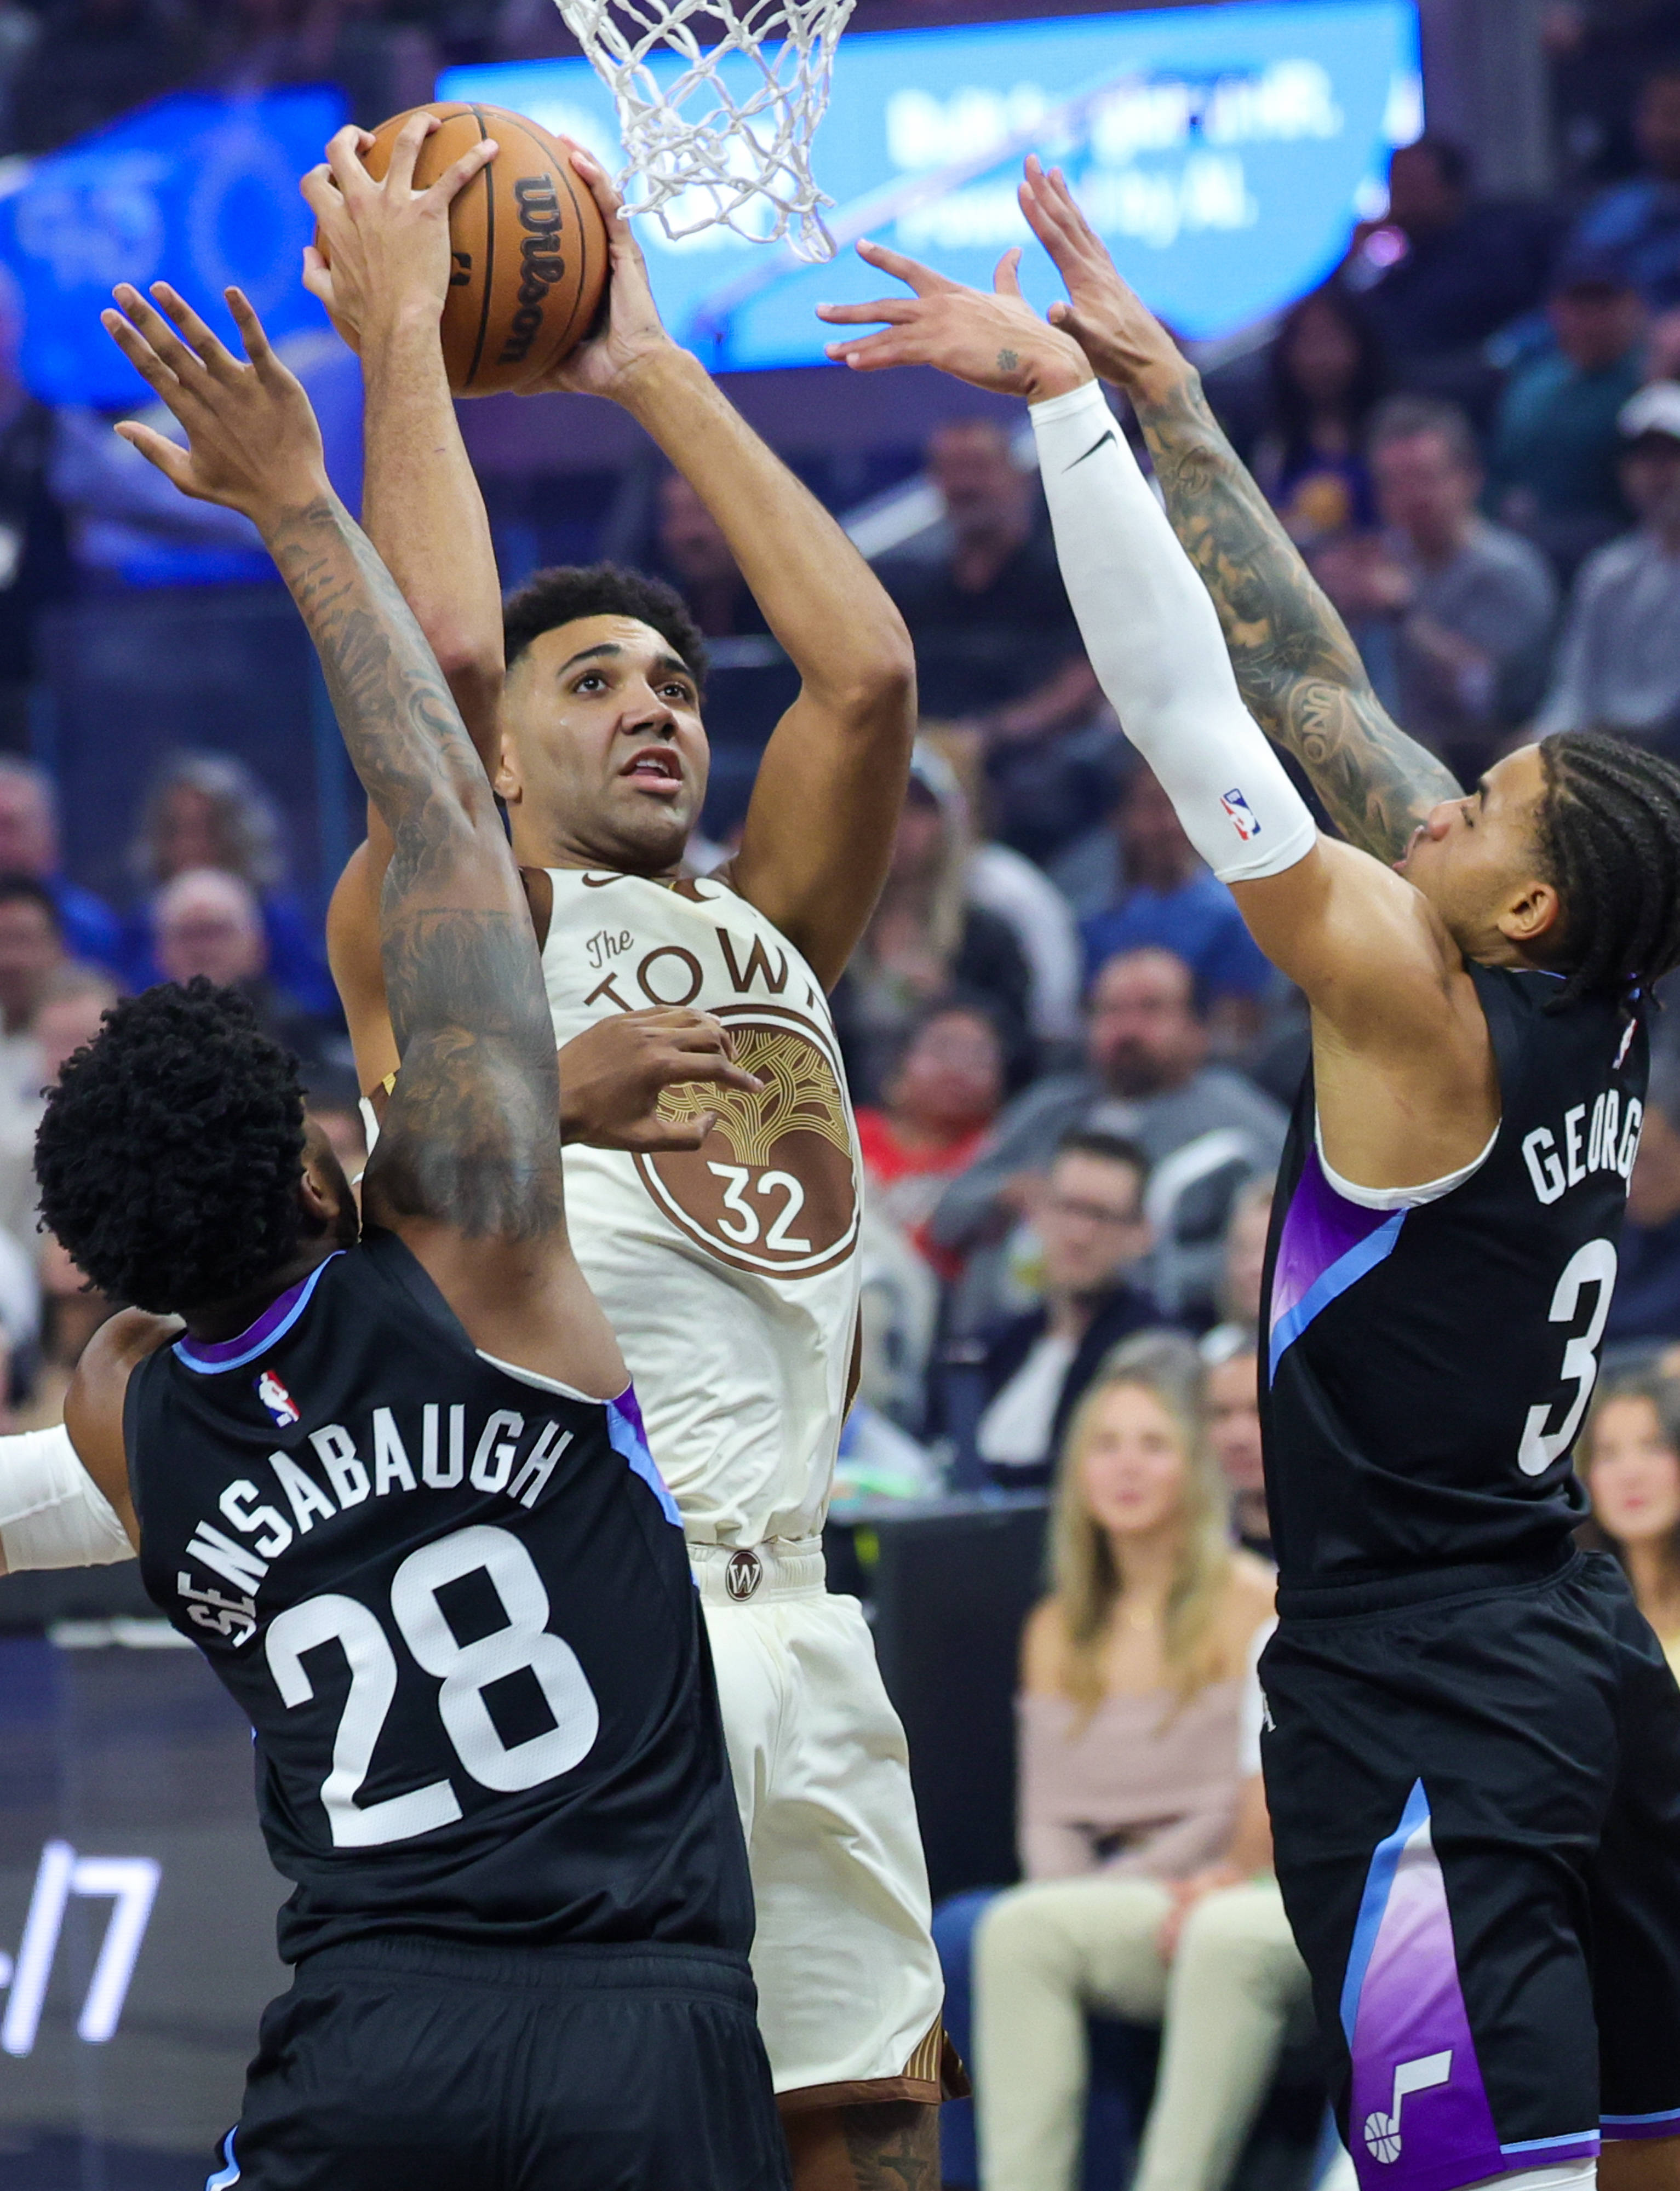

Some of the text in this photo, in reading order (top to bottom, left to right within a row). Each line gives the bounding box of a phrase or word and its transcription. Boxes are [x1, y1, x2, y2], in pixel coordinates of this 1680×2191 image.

[497, 172, 565, 366] Wilson
[583, 926, 832, 1023] TOW
[586, 930, 634, 969] The
[1521, 1088, 1643, 1205] GEORG
[707, 1161, 811, 1253] 32
[1518, 1238, 1618, 1476] 3
[177, 1403, 574, 1648] SENSABAUGH
[728, 1563, 761, 1595] W
[265, 1524, 599, 1848] 28
